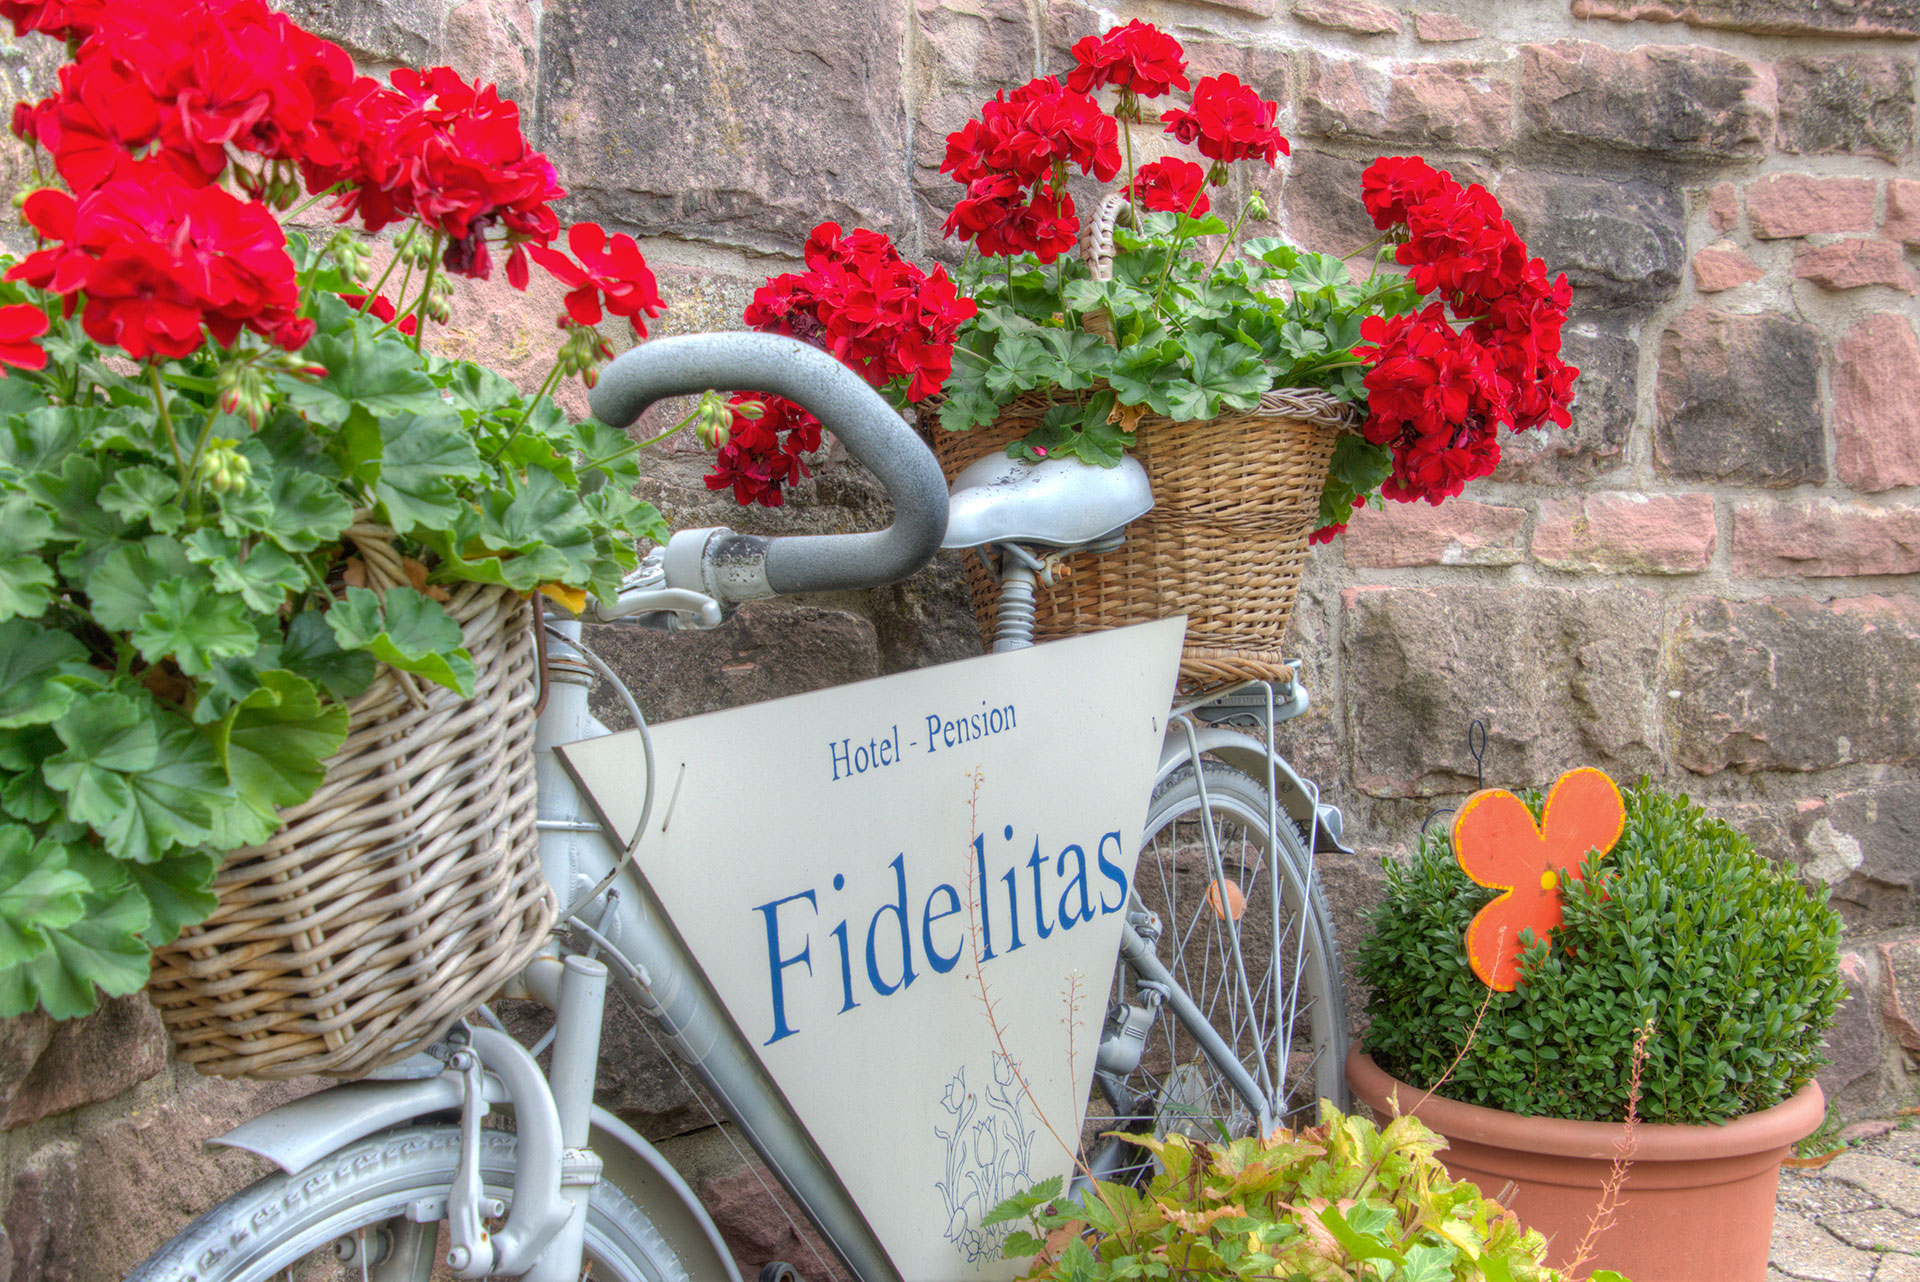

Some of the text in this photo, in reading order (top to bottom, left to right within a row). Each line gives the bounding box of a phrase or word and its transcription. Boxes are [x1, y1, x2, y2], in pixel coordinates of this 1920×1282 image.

[829, 724, 901, 781] Hotel
[925, 700, 1017, 753] Pension
[752, 825, 1129, 1046] Fidelitas
